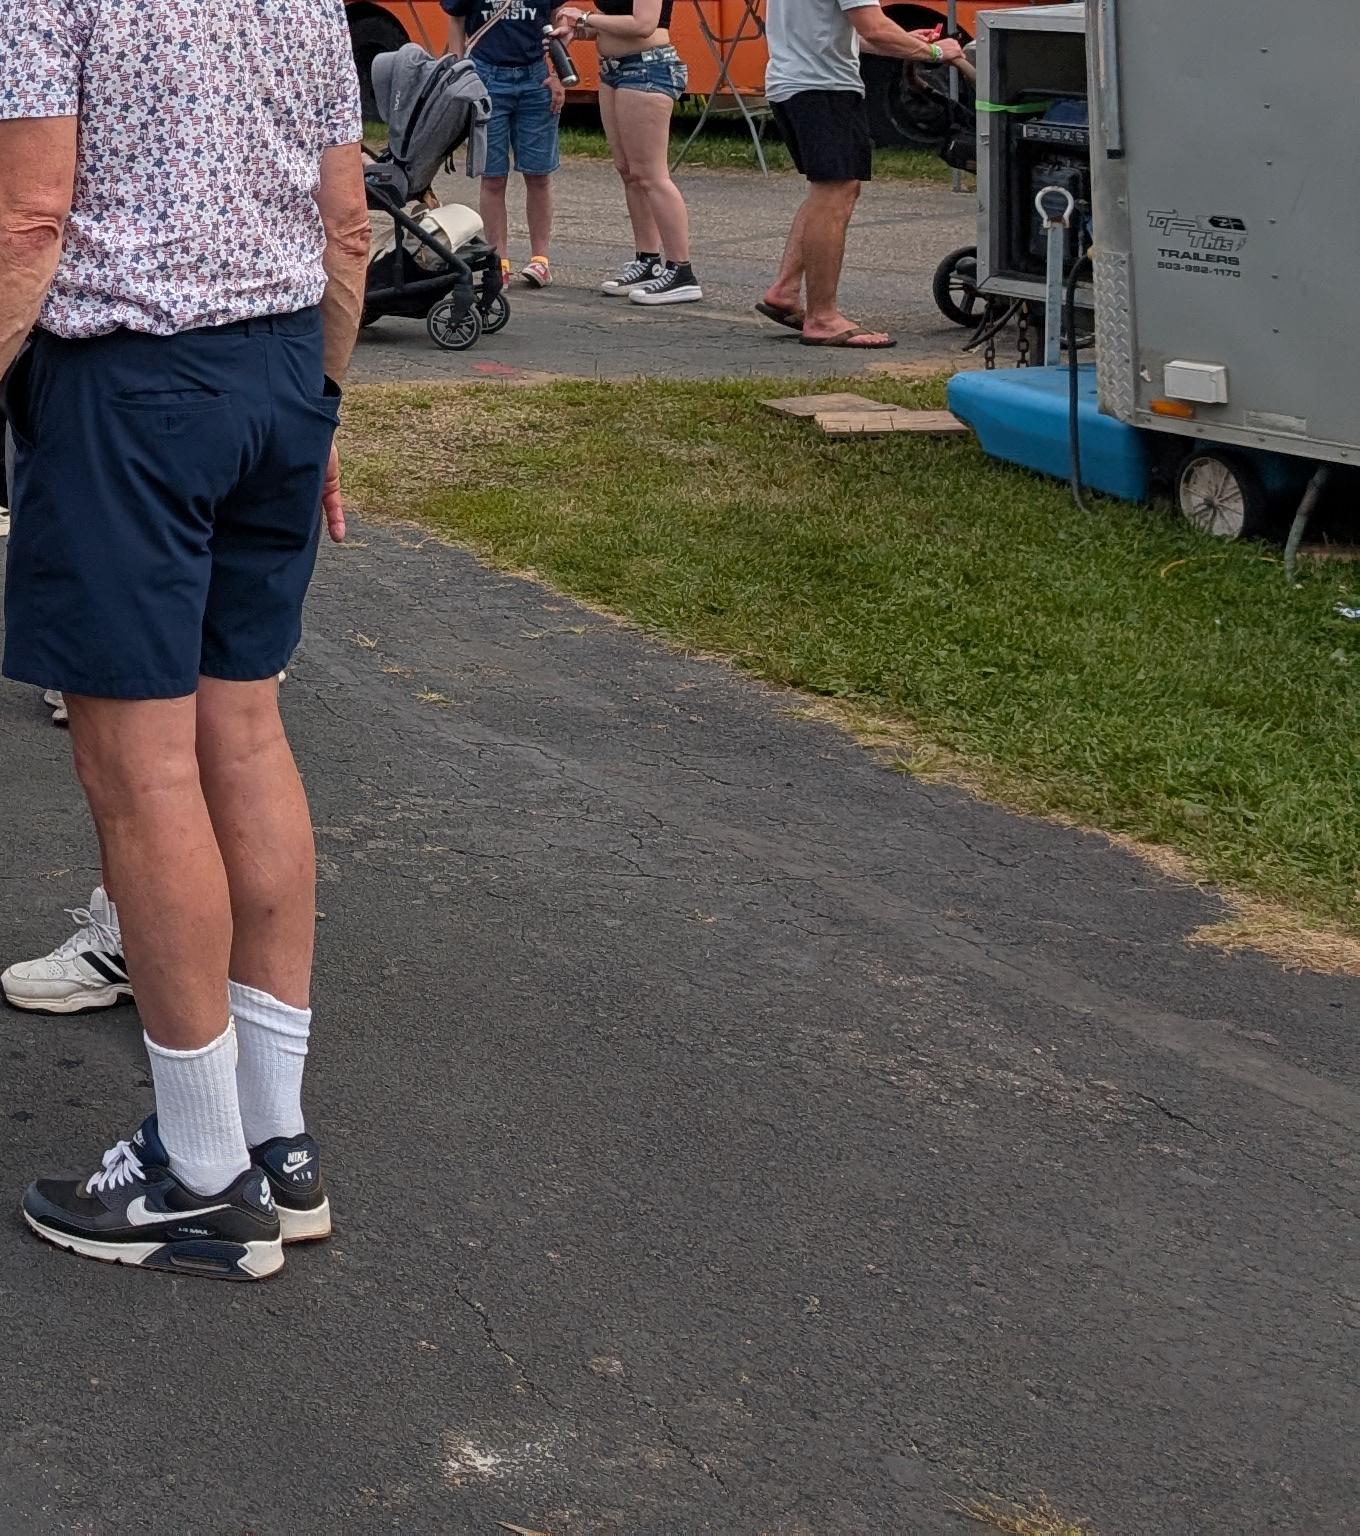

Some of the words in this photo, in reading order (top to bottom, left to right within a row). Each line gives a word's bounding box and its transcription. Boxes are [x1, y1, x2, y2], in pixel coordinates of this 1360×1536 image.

[481, 7, 537, 22] THRSTY
[1157, 248, 1240, 266] TRAILERS
[287, 1149, 309, 1164] NIKE
[292, 1170, 313, 1183] AIR
